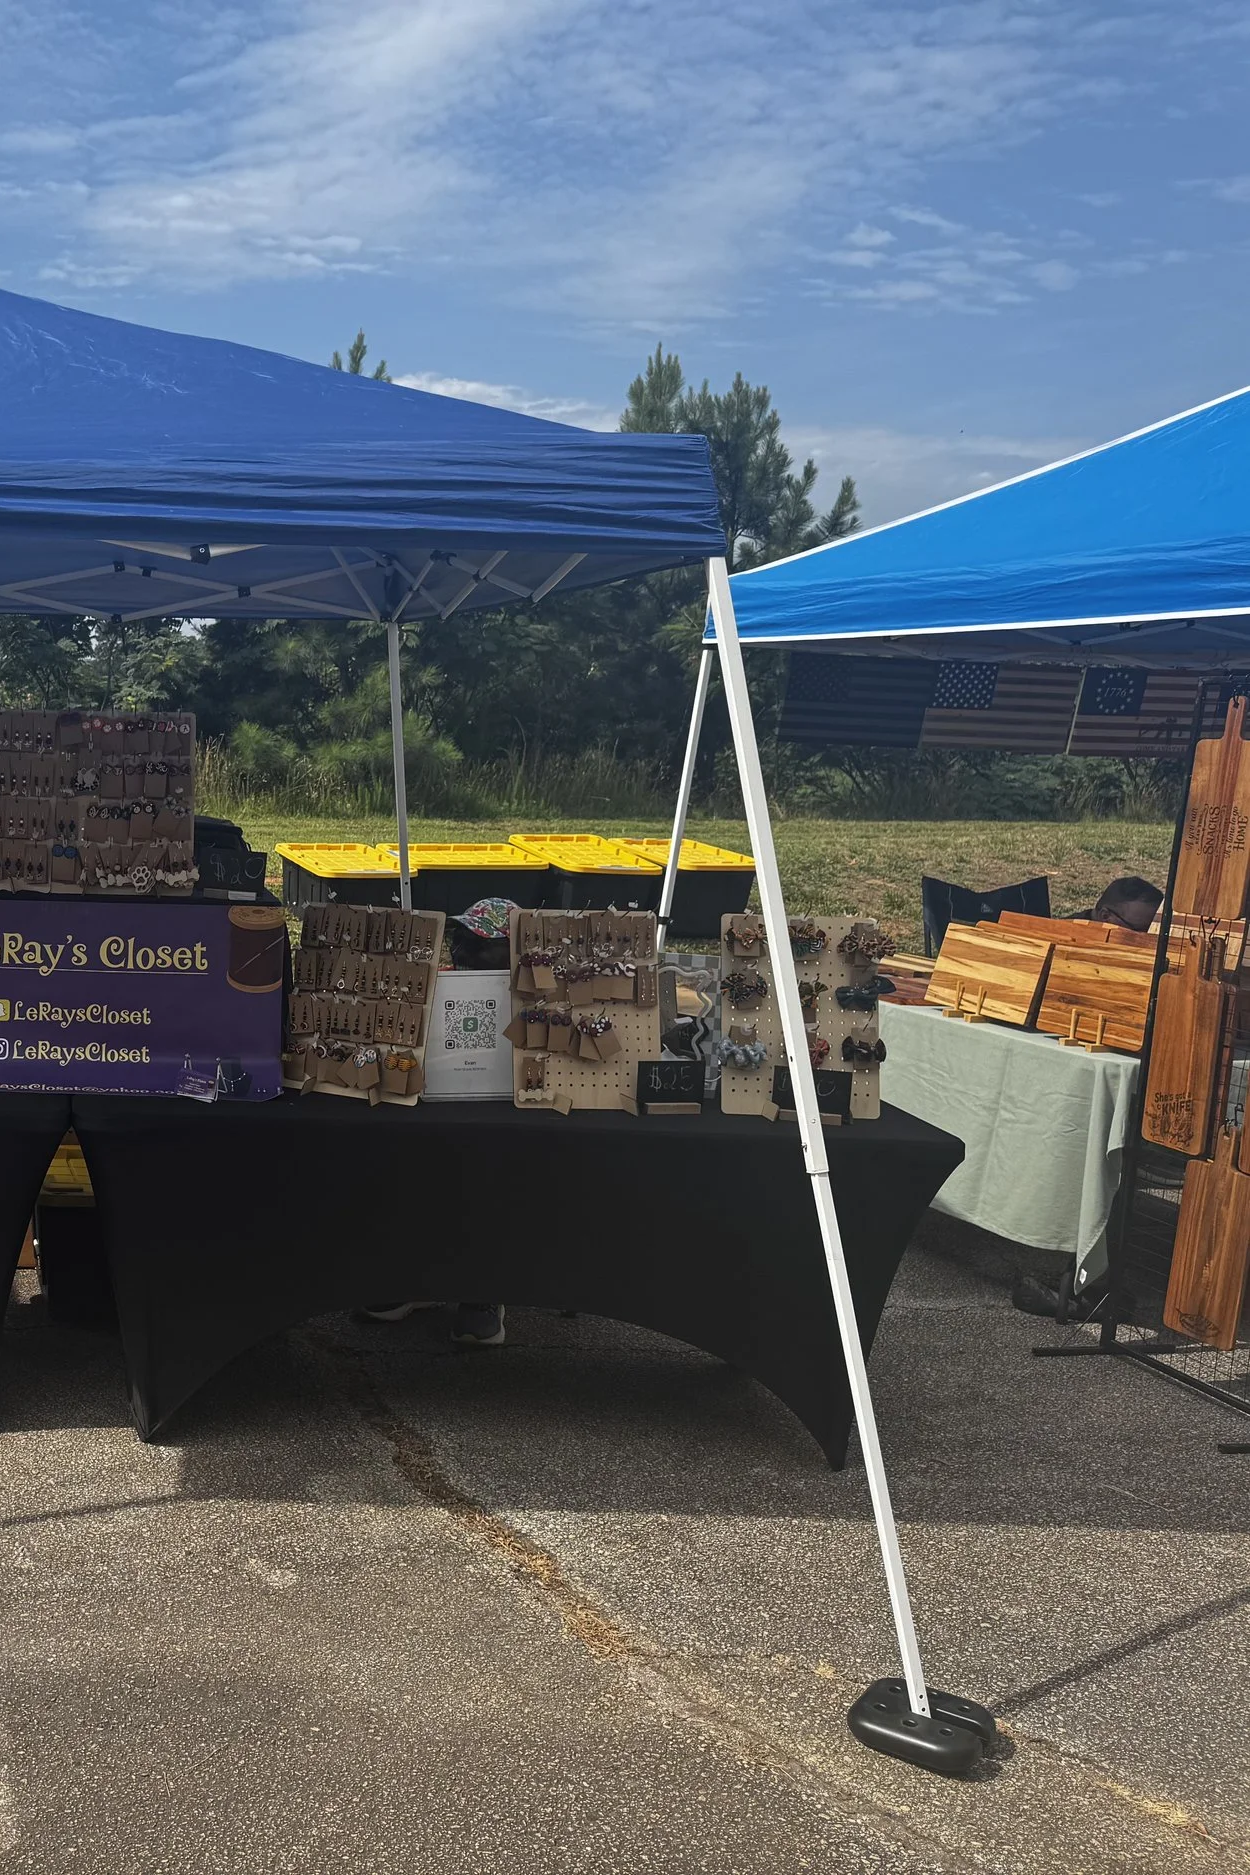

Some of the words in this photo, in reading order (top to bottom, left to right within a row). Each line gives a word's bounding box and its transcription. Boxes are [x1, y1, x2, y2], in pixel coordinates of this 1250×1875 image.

[1103, 687, 1128, 698] 1776
[1203, 805, 1220, 855] SNACKS
[1233, 815, 1249, 852] HOME
[99, 935, 209, 971] Closet
[13, 1000, 152, 1028] LeRaysCloset
[12, 1039, 151, 1066] LeRaysCloset
[649, 1065, 694, 1092] $25
[1162, 1100, 1192, 1116] KNIFE
